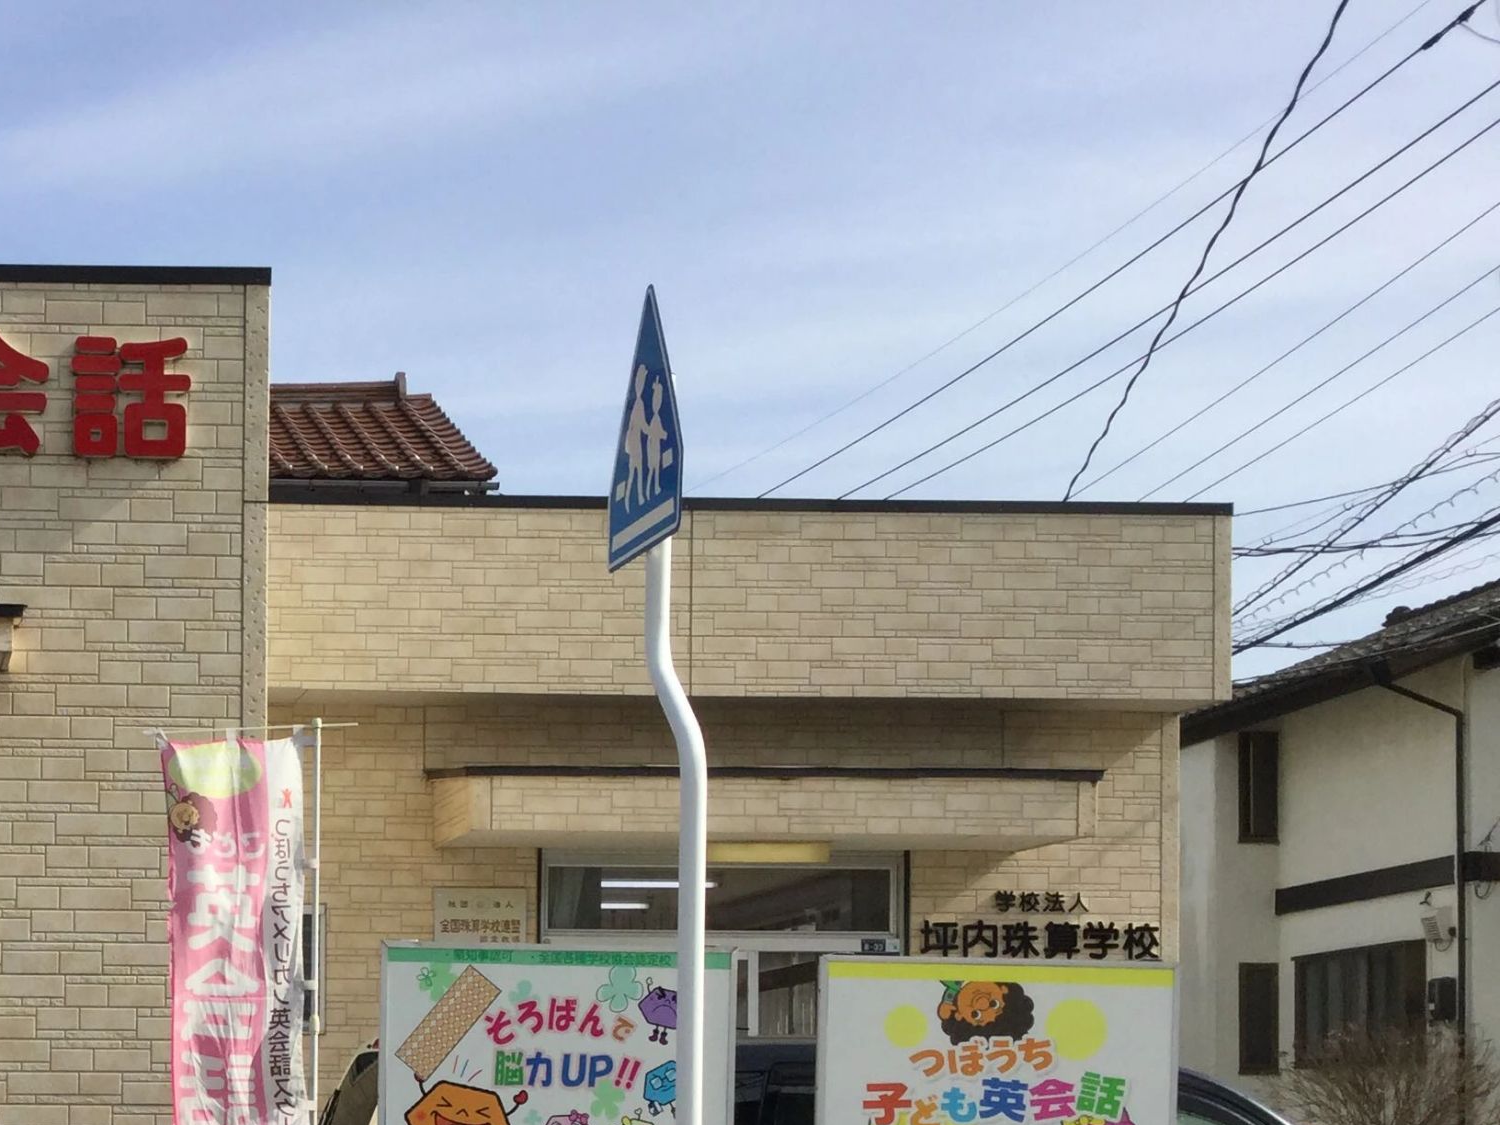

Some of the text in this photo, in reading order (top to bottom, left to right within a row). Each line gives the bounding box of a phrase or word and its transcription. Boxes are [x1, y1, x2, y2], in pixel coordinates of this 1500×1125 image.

[994, 890, 1089, 913] 学校法人
[920, 920, 1160, 959] 坪内珠算学校
[484, 998, 637, 1045] そろばんで
[909, 1038, 1053, 1077] つぼうち
